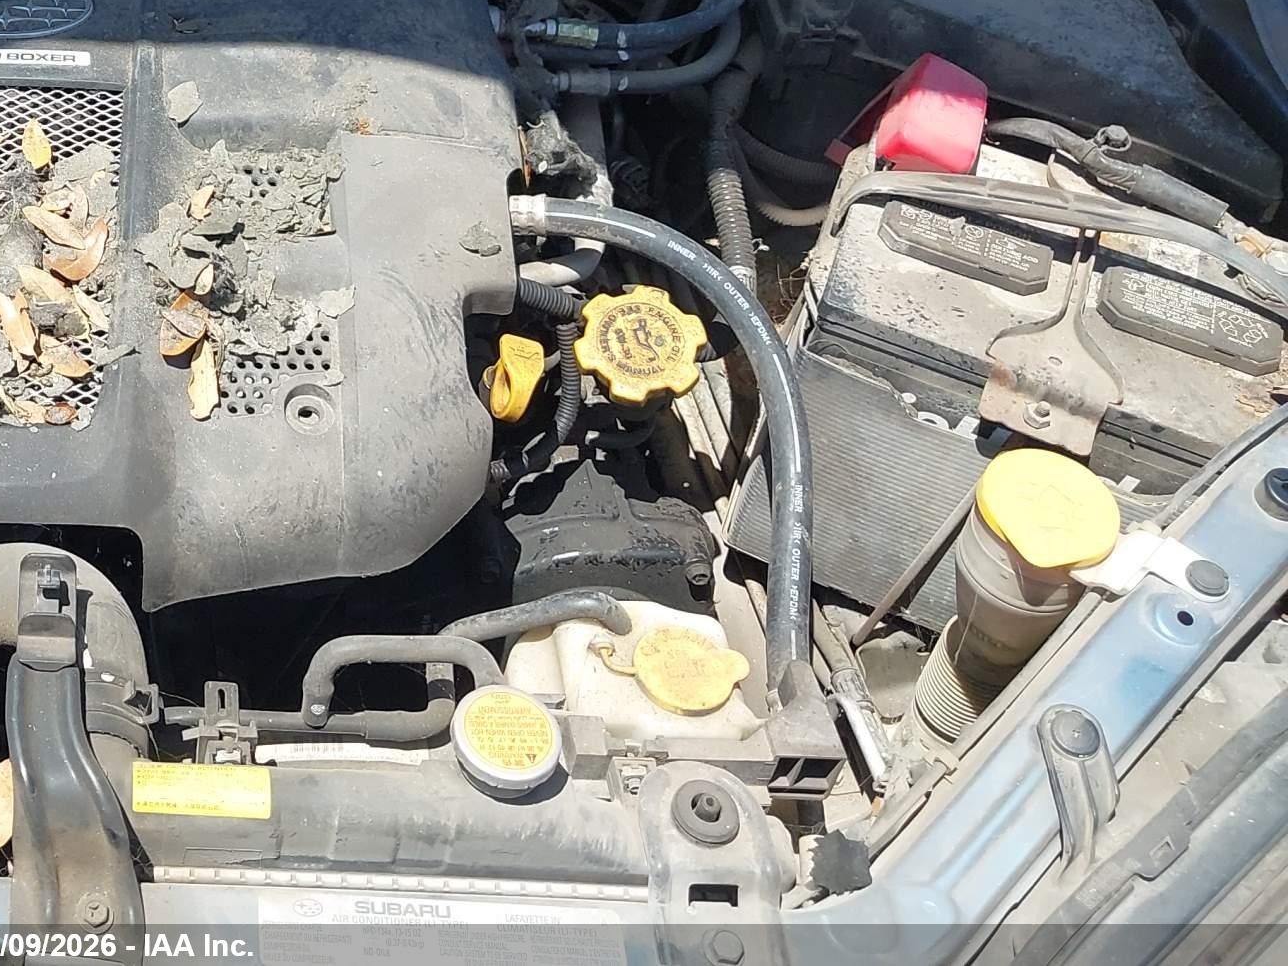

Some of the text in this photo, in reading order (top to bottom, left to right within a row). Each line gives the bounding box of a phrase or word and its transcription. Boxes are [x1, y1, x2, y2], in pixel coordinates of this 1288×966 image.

[6, 52, 76, 63] BOXER
[667, 240, 697, 262] INNER
[723, 283, 751, 310] OUTER
[647, 307, 681, 363] ENGINE OIL
[616, 360, 665, 376] MANUAL
[794, 484, 802, 514] INNER
[790, 548, 800, 582] OUTER
[332, 914, 349, 923] AIR
[352, 915, 421, 927] CONDITIONER
[354, 901, 451, 919] SUBARU
